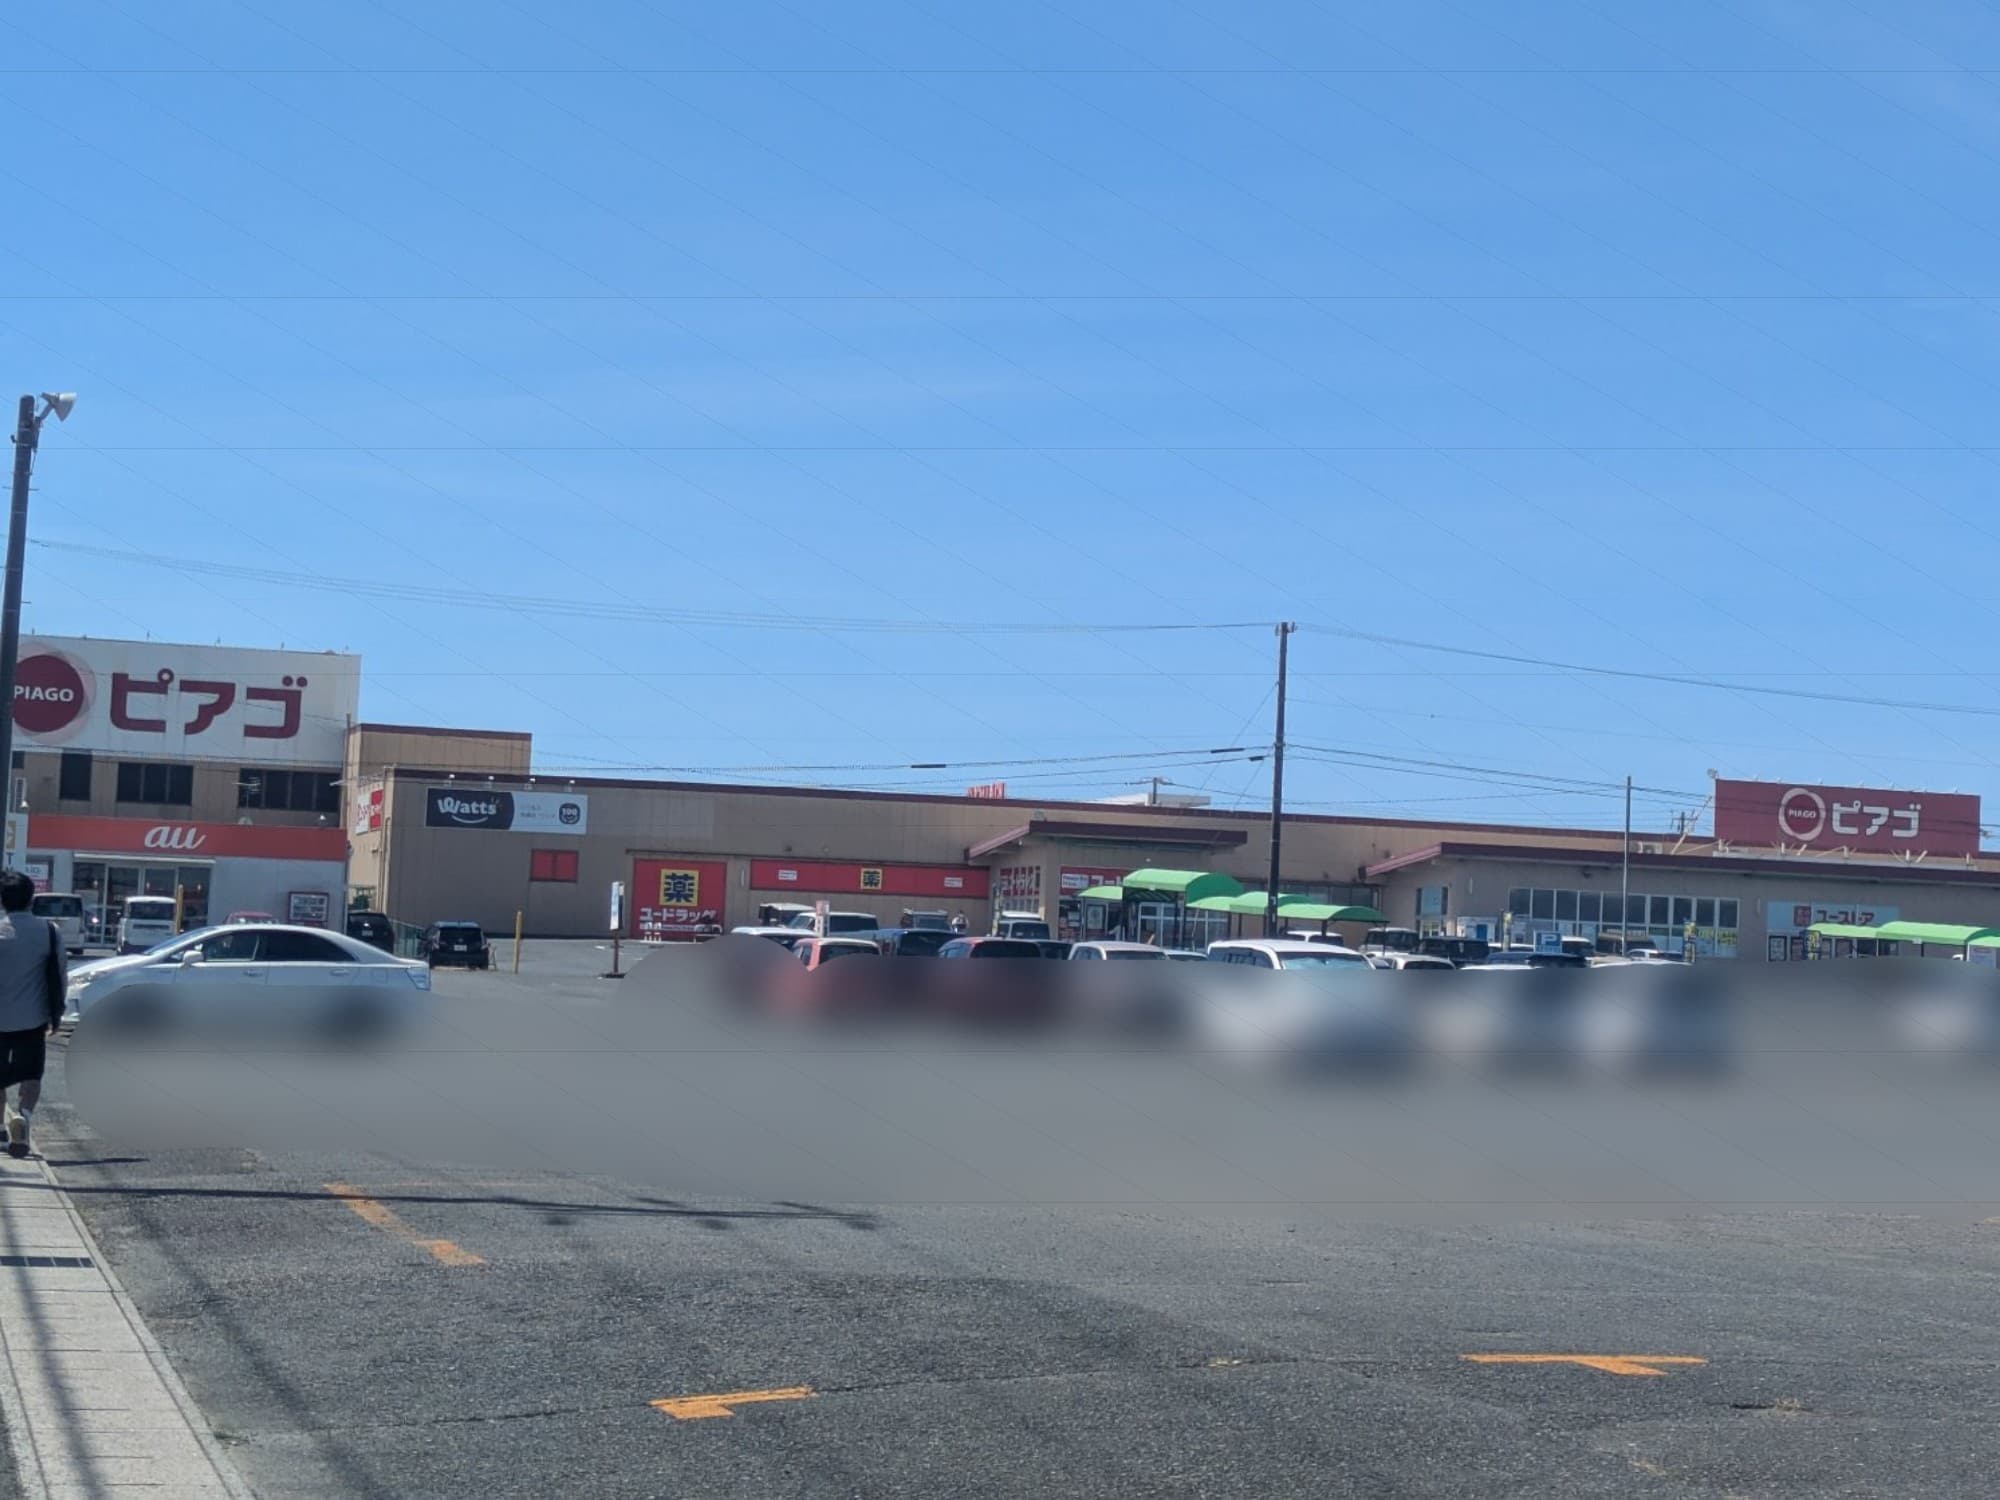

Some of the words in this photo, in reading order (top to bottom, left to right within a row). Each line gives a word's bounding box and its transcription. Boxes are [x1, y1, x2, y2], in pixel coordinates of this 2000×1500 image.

[14, 685, 74, 702] PIAGO
[110, 668, 308, 739] ピアゴ
[437, 797, 498, 815] Watts
[1832, 800, 1921, 838] ピアゴ
[144, 825, 207, 850] au
[663, 872, 696, 903] 薬
[863, 870, 881, 887] 薬
[1541, 934, 1557, 945] P
